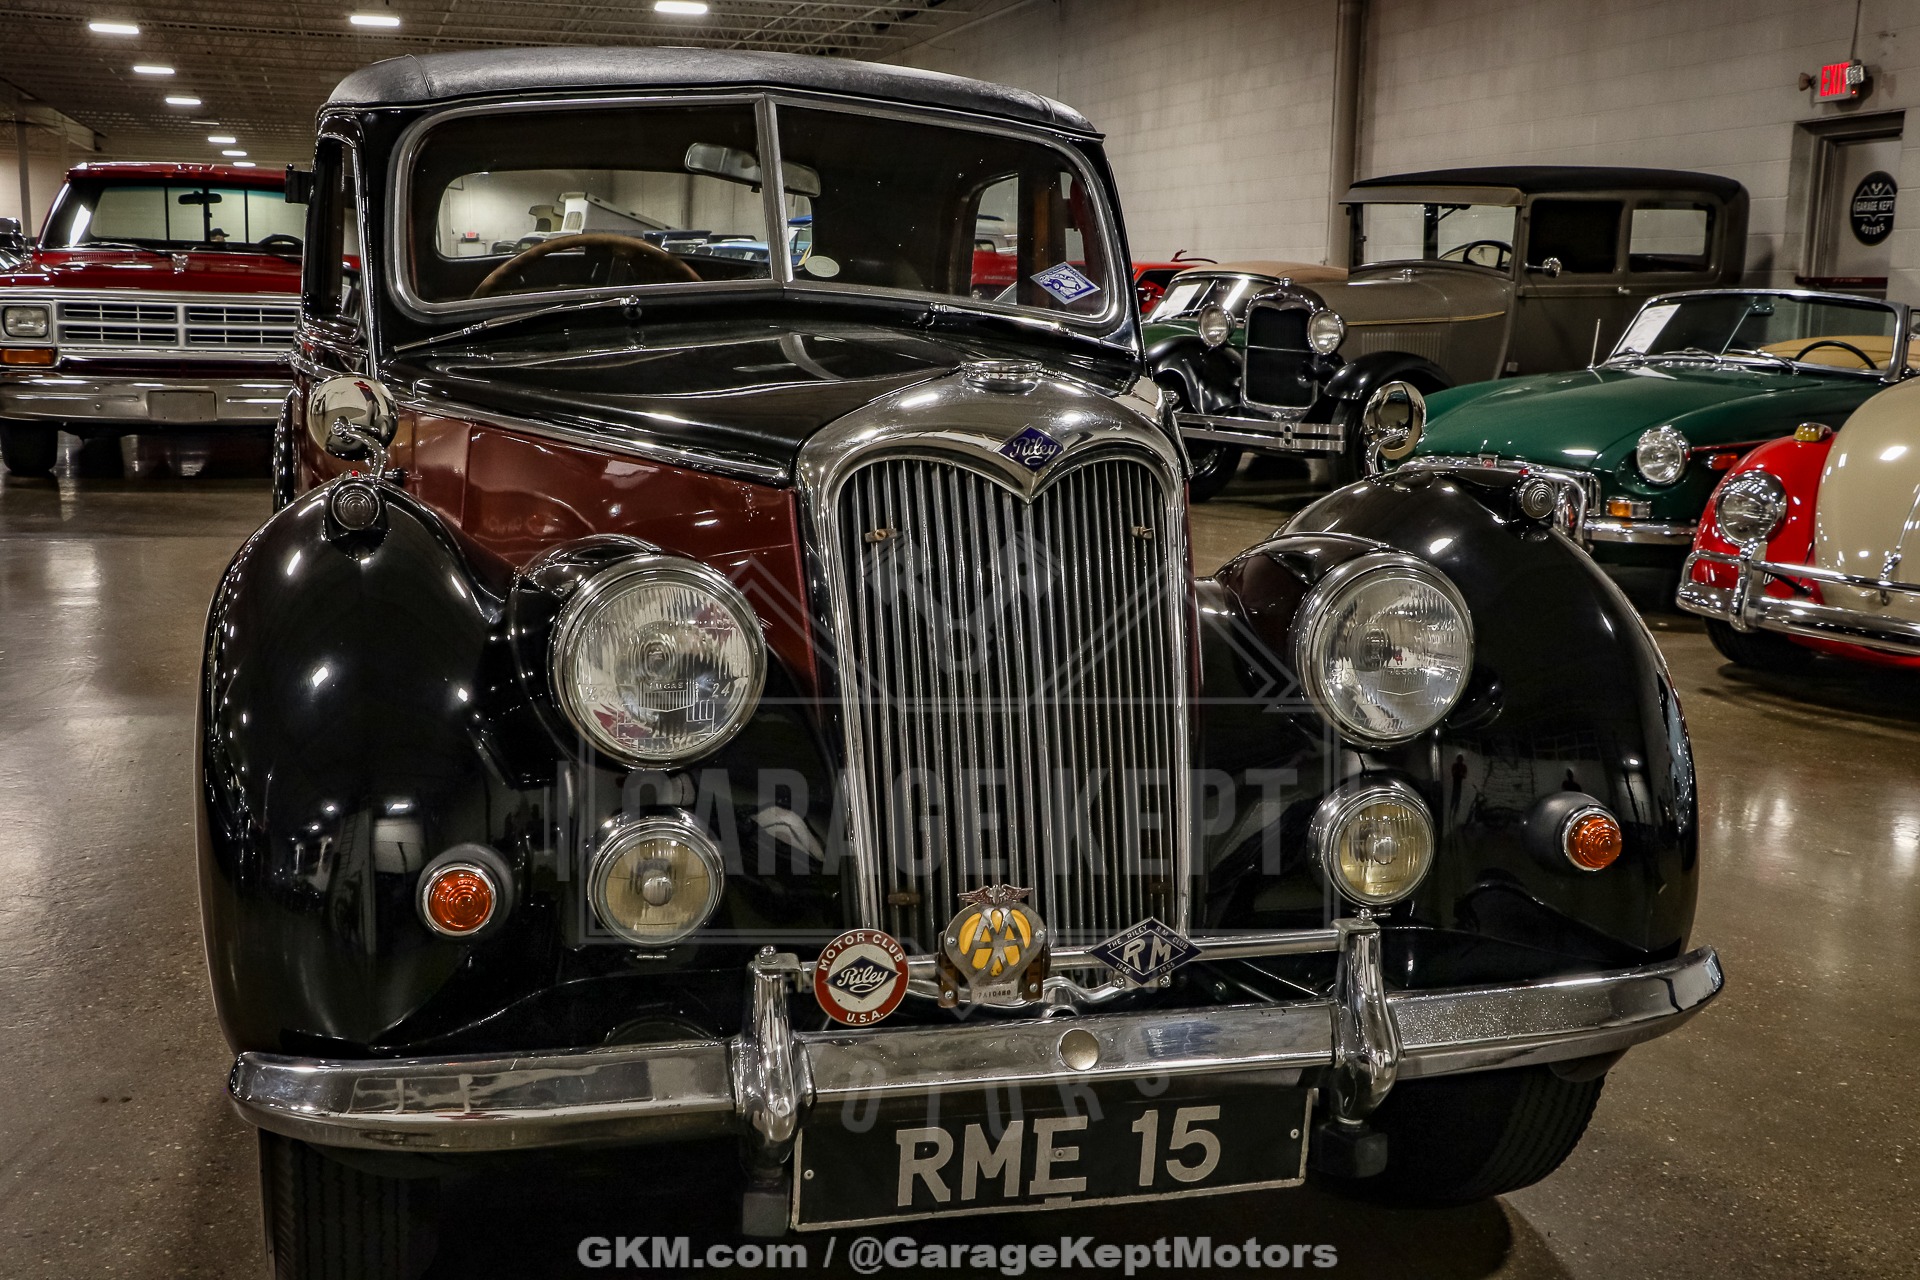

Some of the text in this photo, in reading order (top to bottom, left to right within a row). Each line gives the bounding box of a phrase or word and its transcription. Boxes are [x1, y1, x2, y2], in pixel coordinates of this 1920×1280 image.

[1820, 62, 1850, 97] EXIT
[1879, 200, 1894, 210] KEPT
[1860, 223, 1885, 235] MOTORS
[1009, 436, 1058, 466] Riley
[819, 932, 904, 972] MOTOR CLUB
[1107, 939, 1122, 949] THE
[1126, 925, 1148, 939] RILEY
[1172, 937, 1189, 950] CLUB
[1122, 935, 1172, 971] RM
[836, 965, 889, 993] Riley
[1115, 963, 1130, 974] 1946
[896, 1105, 1221, 1206] RME 15
